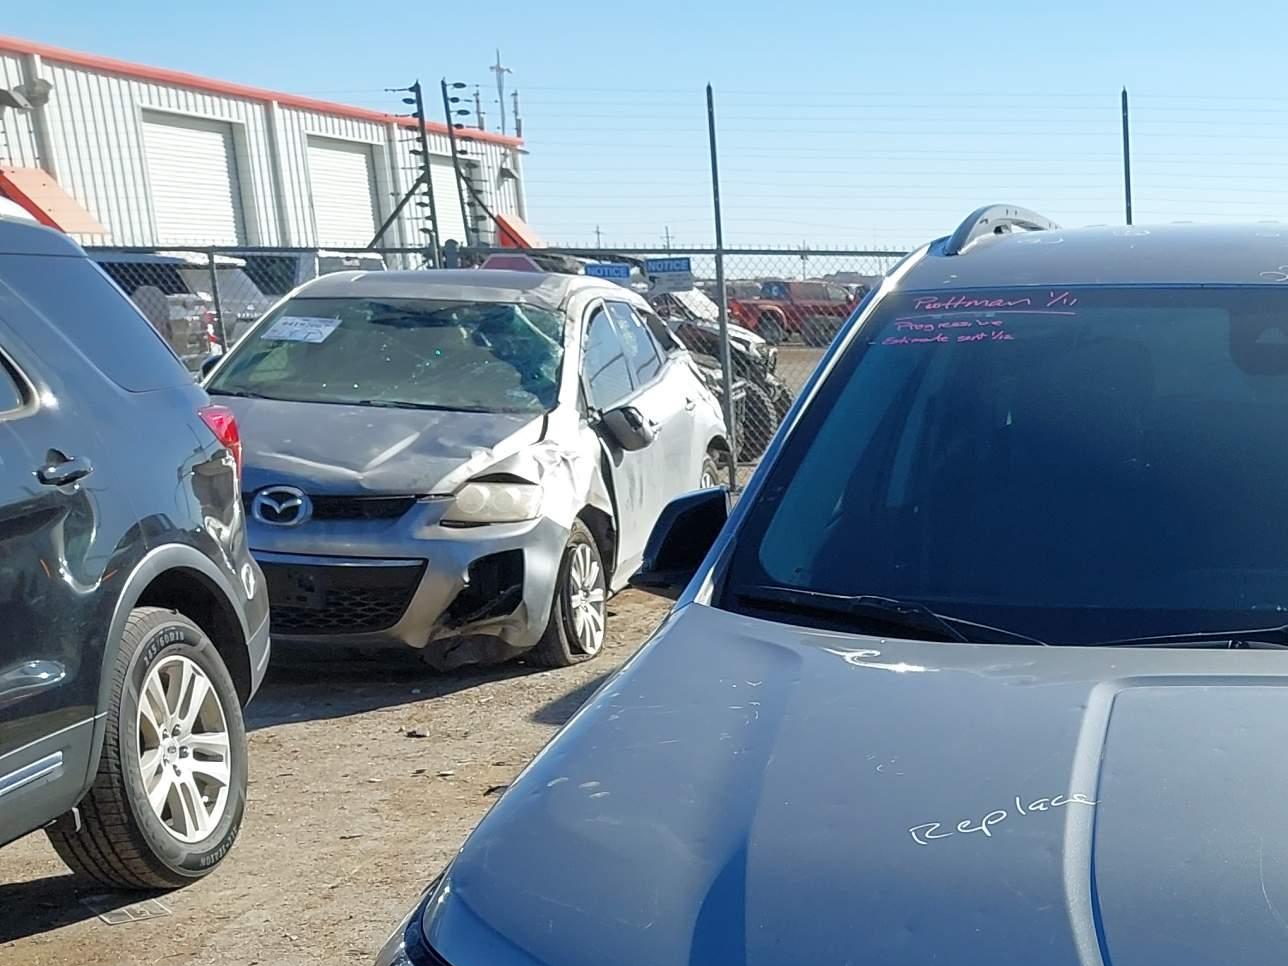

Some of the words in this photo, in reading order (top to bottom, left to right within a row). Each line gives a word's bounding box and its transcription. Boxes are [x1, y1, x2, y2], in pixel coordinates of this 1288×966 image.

[647, 259, 688, 271] NOTICE
[586, 266, 627, 278] NOTICE
[908, 793, 1102, 846] Replace
